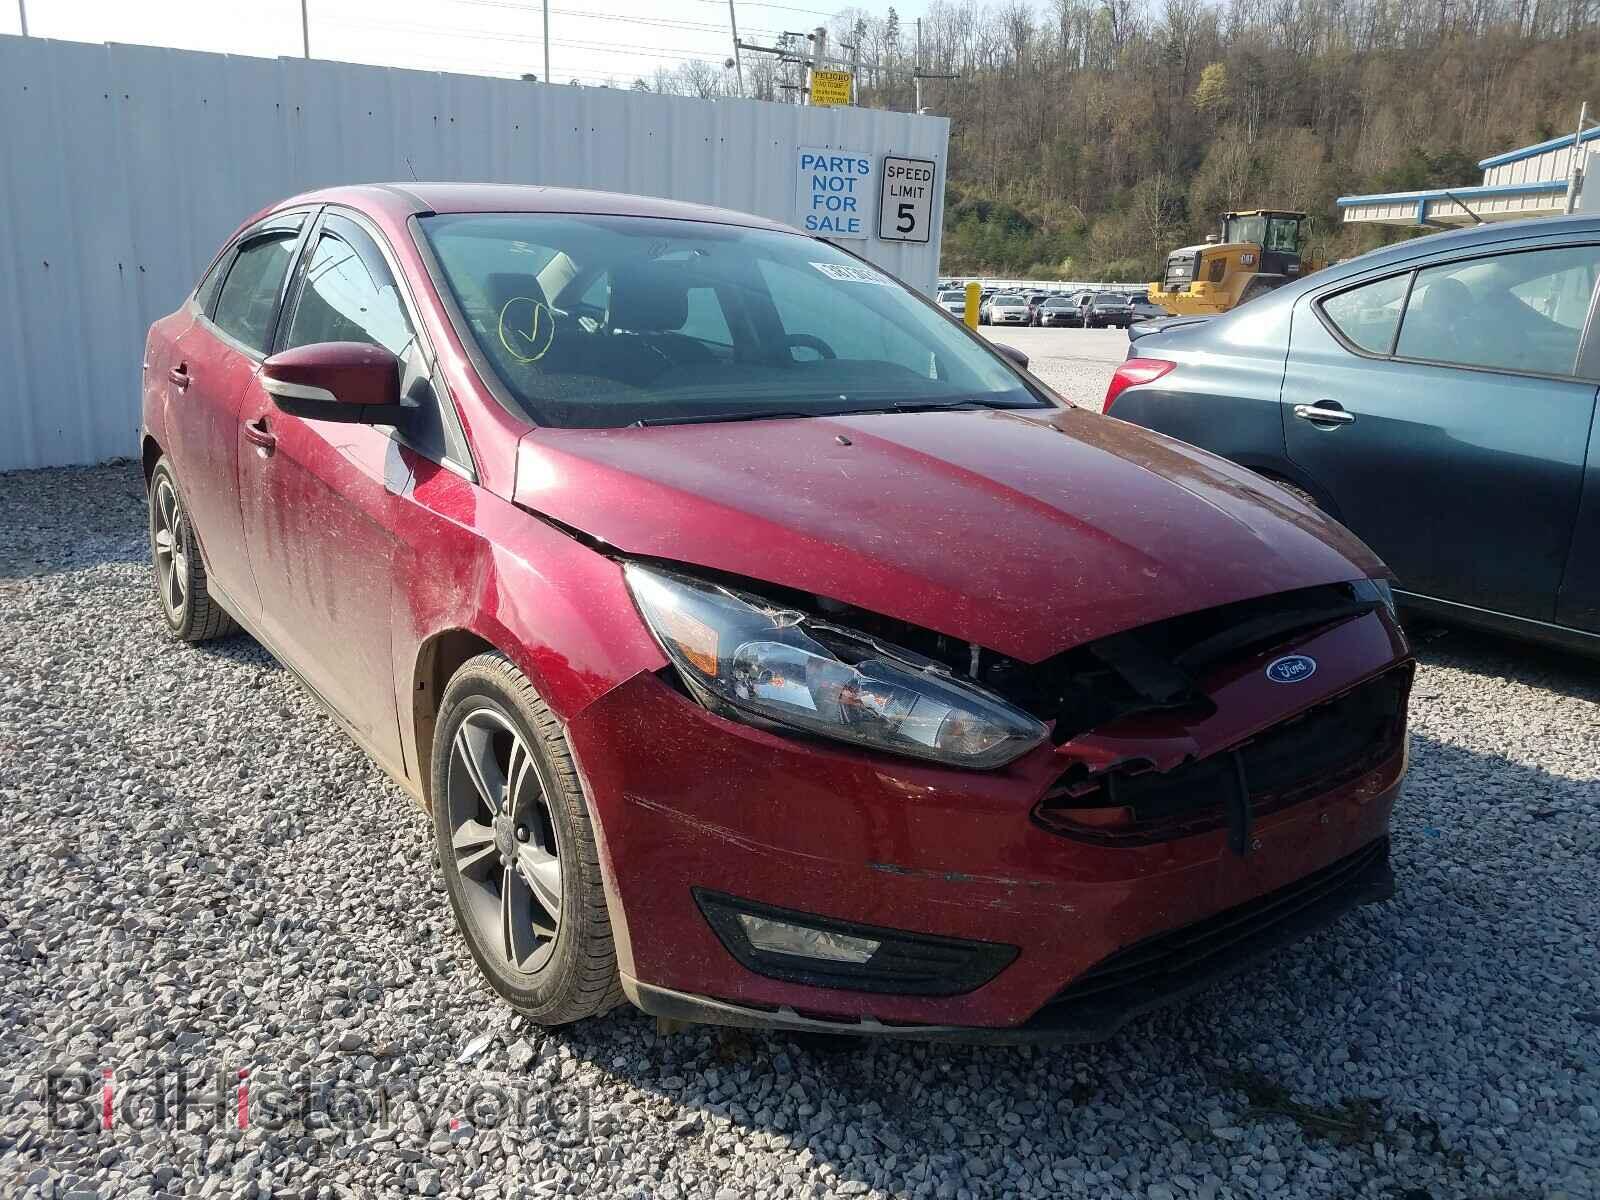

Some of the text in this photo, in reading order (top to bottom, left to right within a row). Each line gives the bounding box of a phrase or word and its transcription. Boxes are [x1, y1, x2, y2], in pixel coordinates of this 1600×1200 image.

[801, 154, 870, 175] PARTS
[887, 166, 931, 182] SPEED
[812, 175, 858, 193] NOT
[890, 184, 925, 199] LIMIT
[813, 195, 857, 212] FOR
[805, 215, 861, 233] SALE
[896, 204, 916, 233] 5
[1277, 661, 1307, 678] Ford
